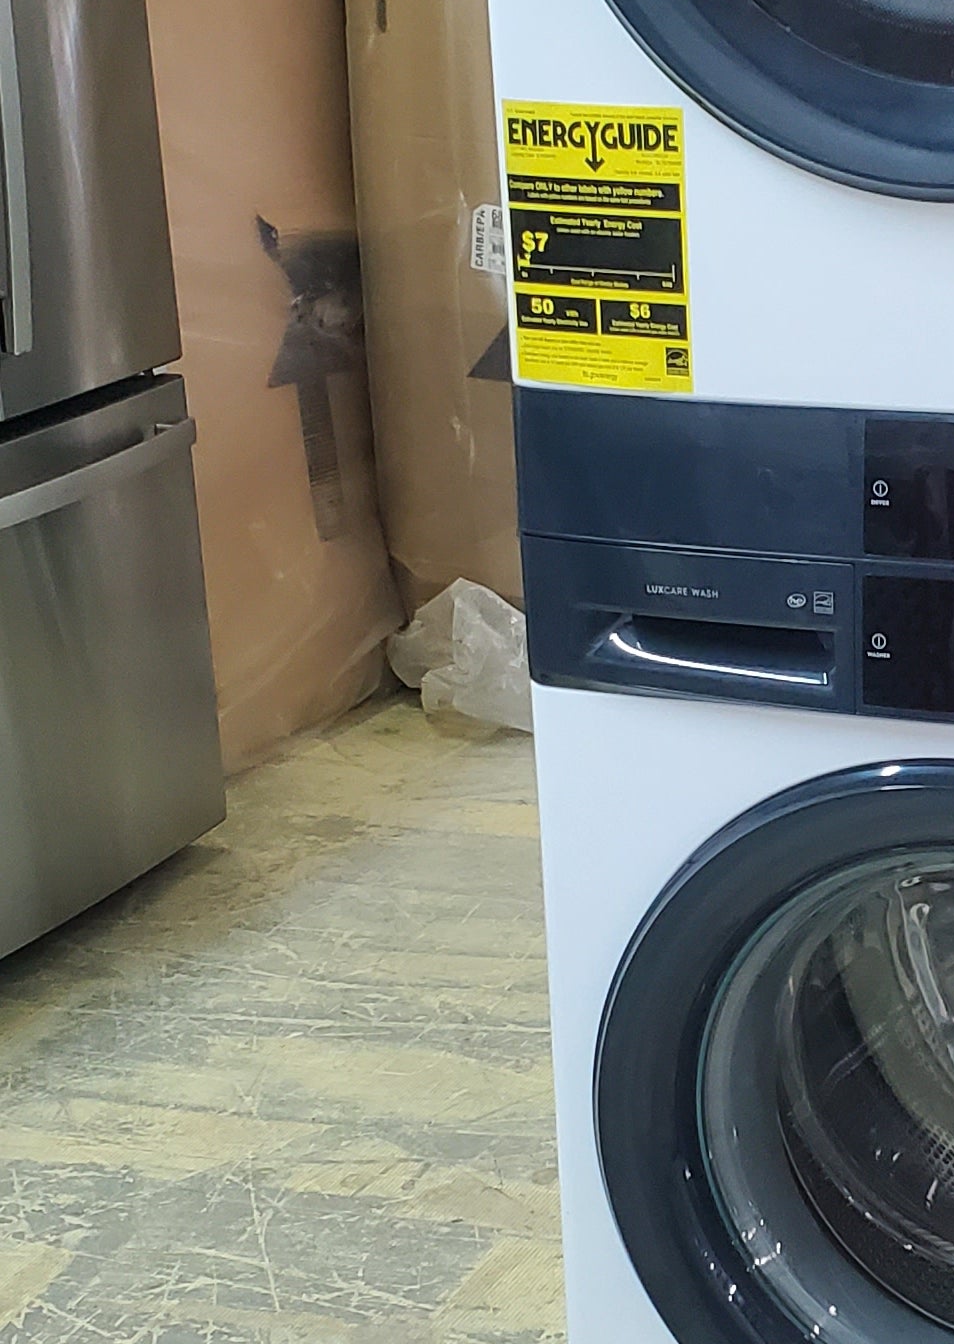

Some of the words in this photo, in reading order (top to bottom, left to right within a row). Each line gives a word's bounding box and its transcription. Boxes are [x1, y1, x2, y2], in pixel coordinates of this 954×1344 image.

[507, 117, 679, 154] ENERGYGUIDE
[475, 210, 486, 267] CARB/EPA
[522, 230, 549, 252] $7
[531, 298, 554, 315] 50
[629, 303, 651, 320] $6
[646, 584, 688, 596] LUXCARE
[691, 587, 719, 599] WASH
